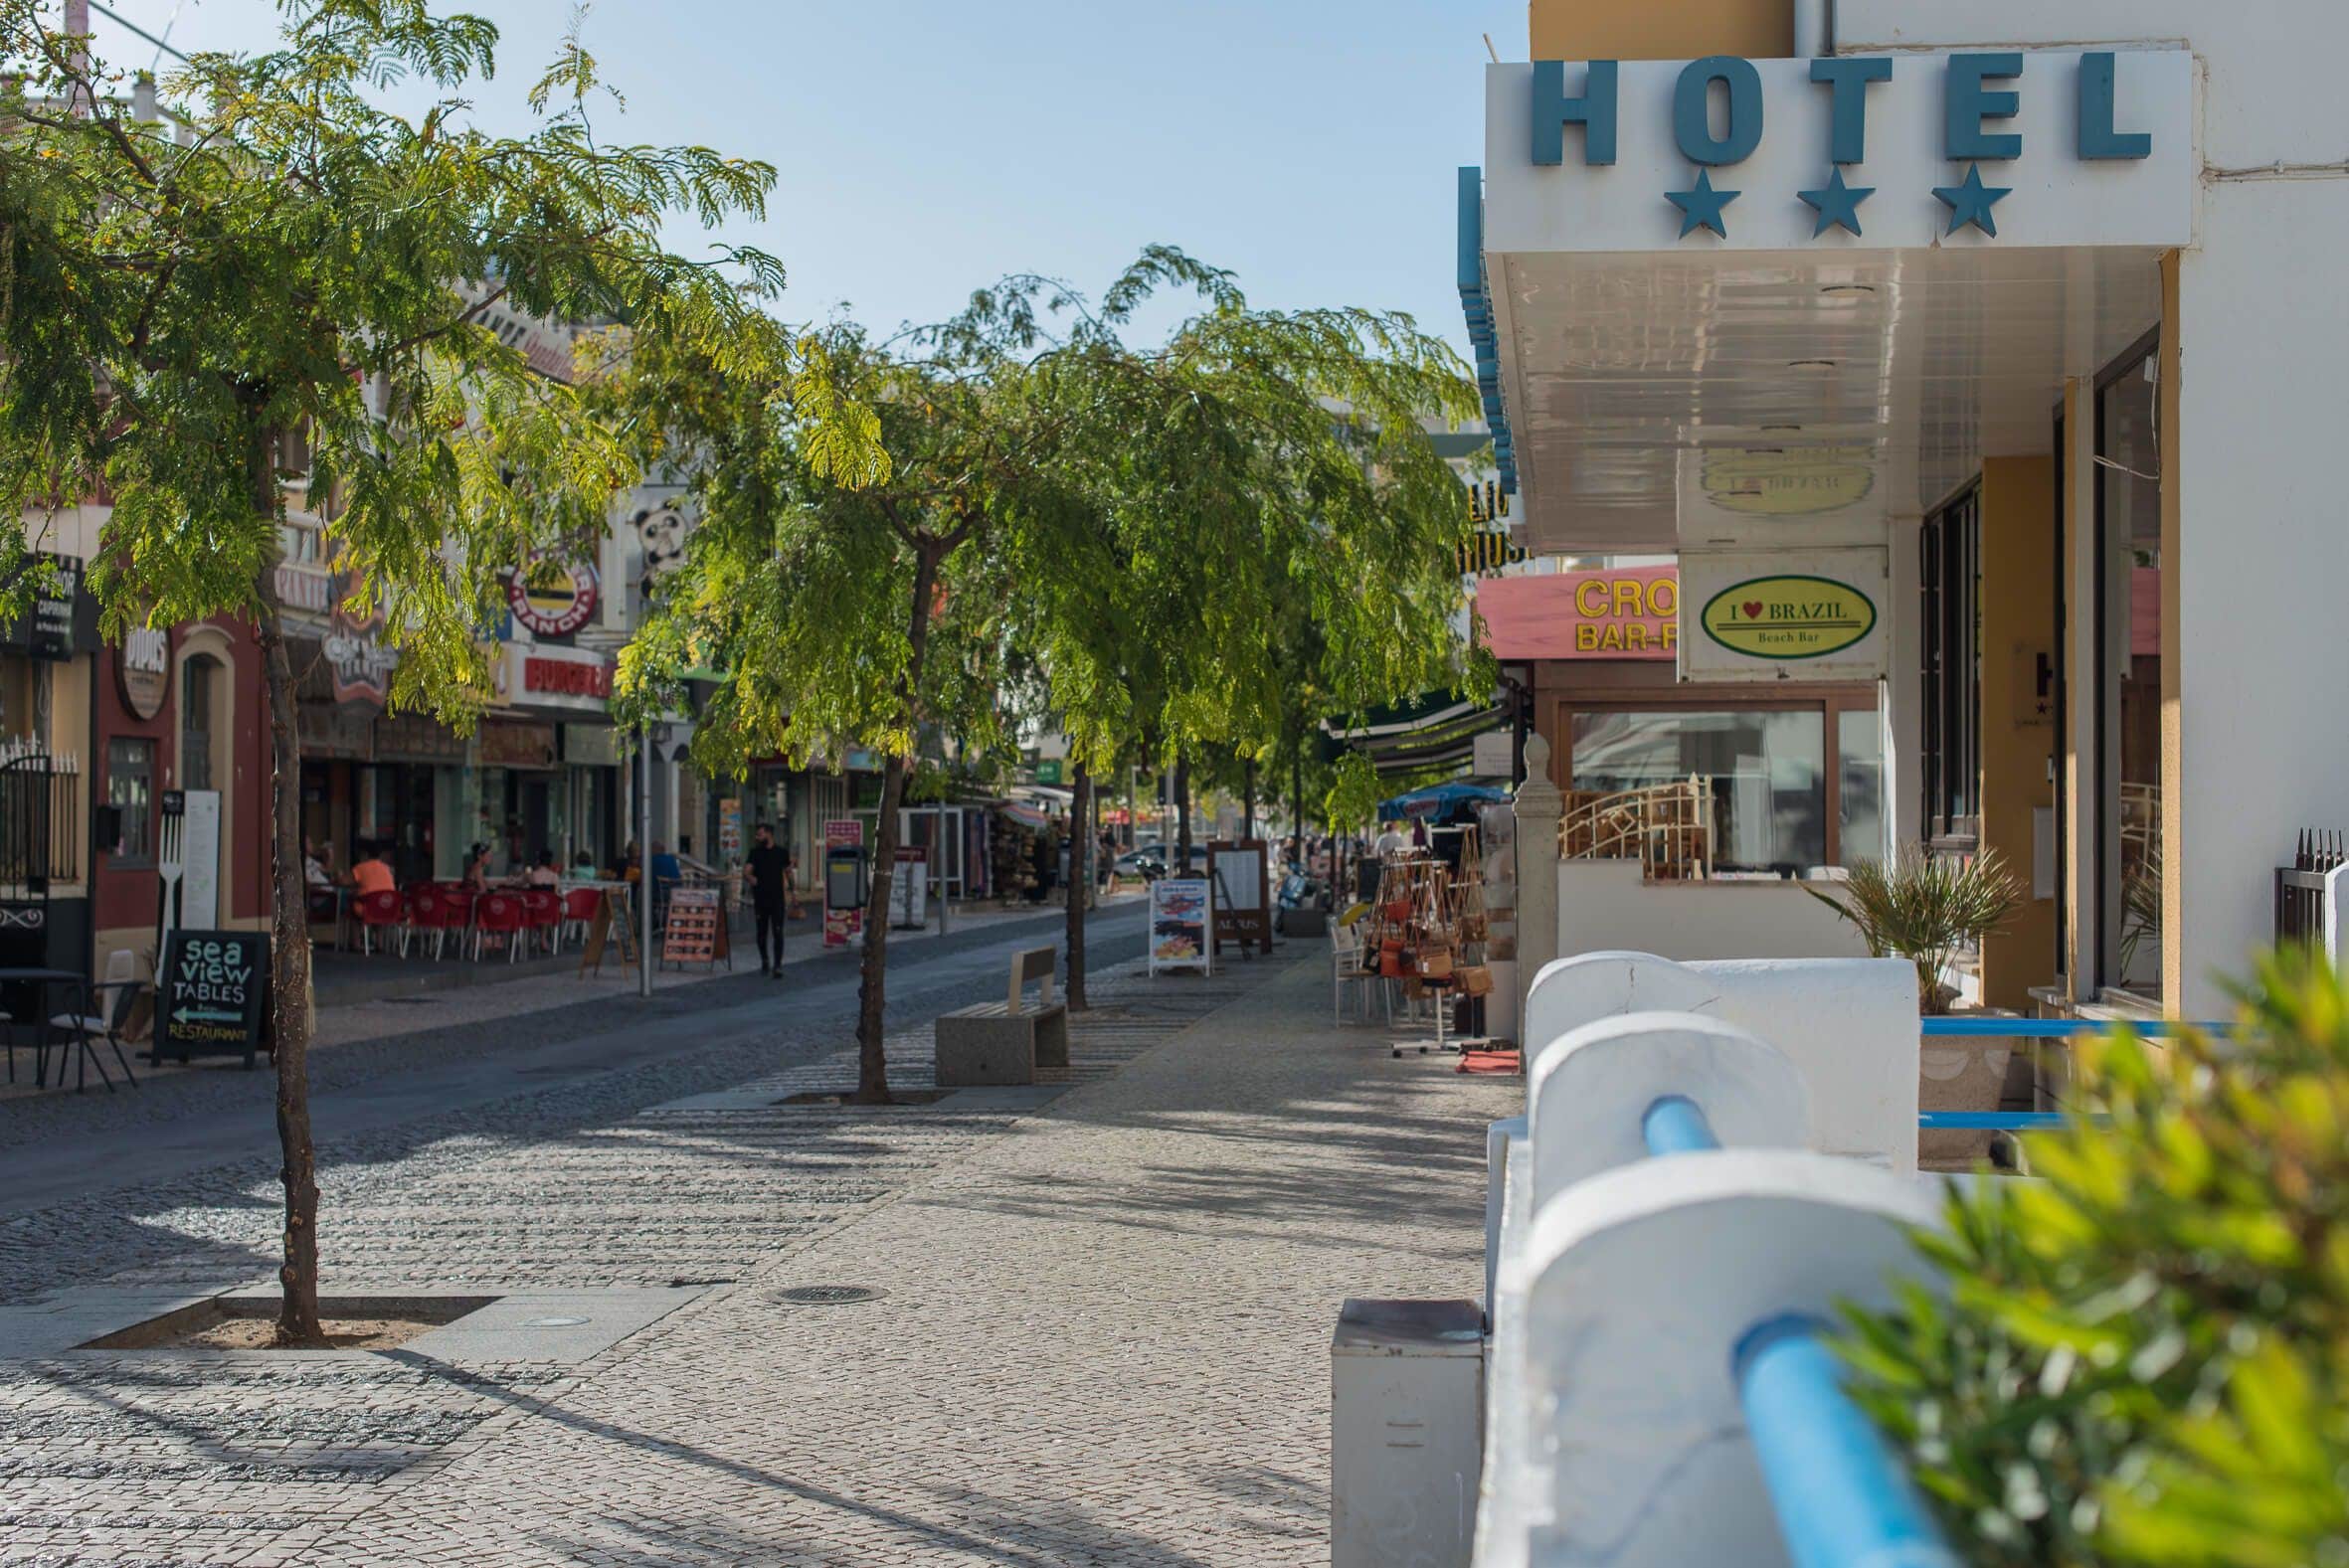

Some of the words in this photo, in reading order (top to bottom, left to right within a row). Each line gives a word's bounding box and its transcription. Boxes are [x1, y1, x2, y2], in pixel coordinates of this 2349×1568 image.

[1532, 52, 2152, 167] HOTEL
[512, 599, 589, 634] RANCH
[1730, 605, 1738, 620] I
[1770, 603, 1847, 619] BRAZIL
[1758, 631, 1794, 643] Beach
[1798, 631, 1819, 643] Bar
[186, 940, 242, 964] sea
[180, 961, 252, 983] view
[173, 981, 246, 1004] TABLES
[168, 1023, 248, 1041] RESTAURANT
